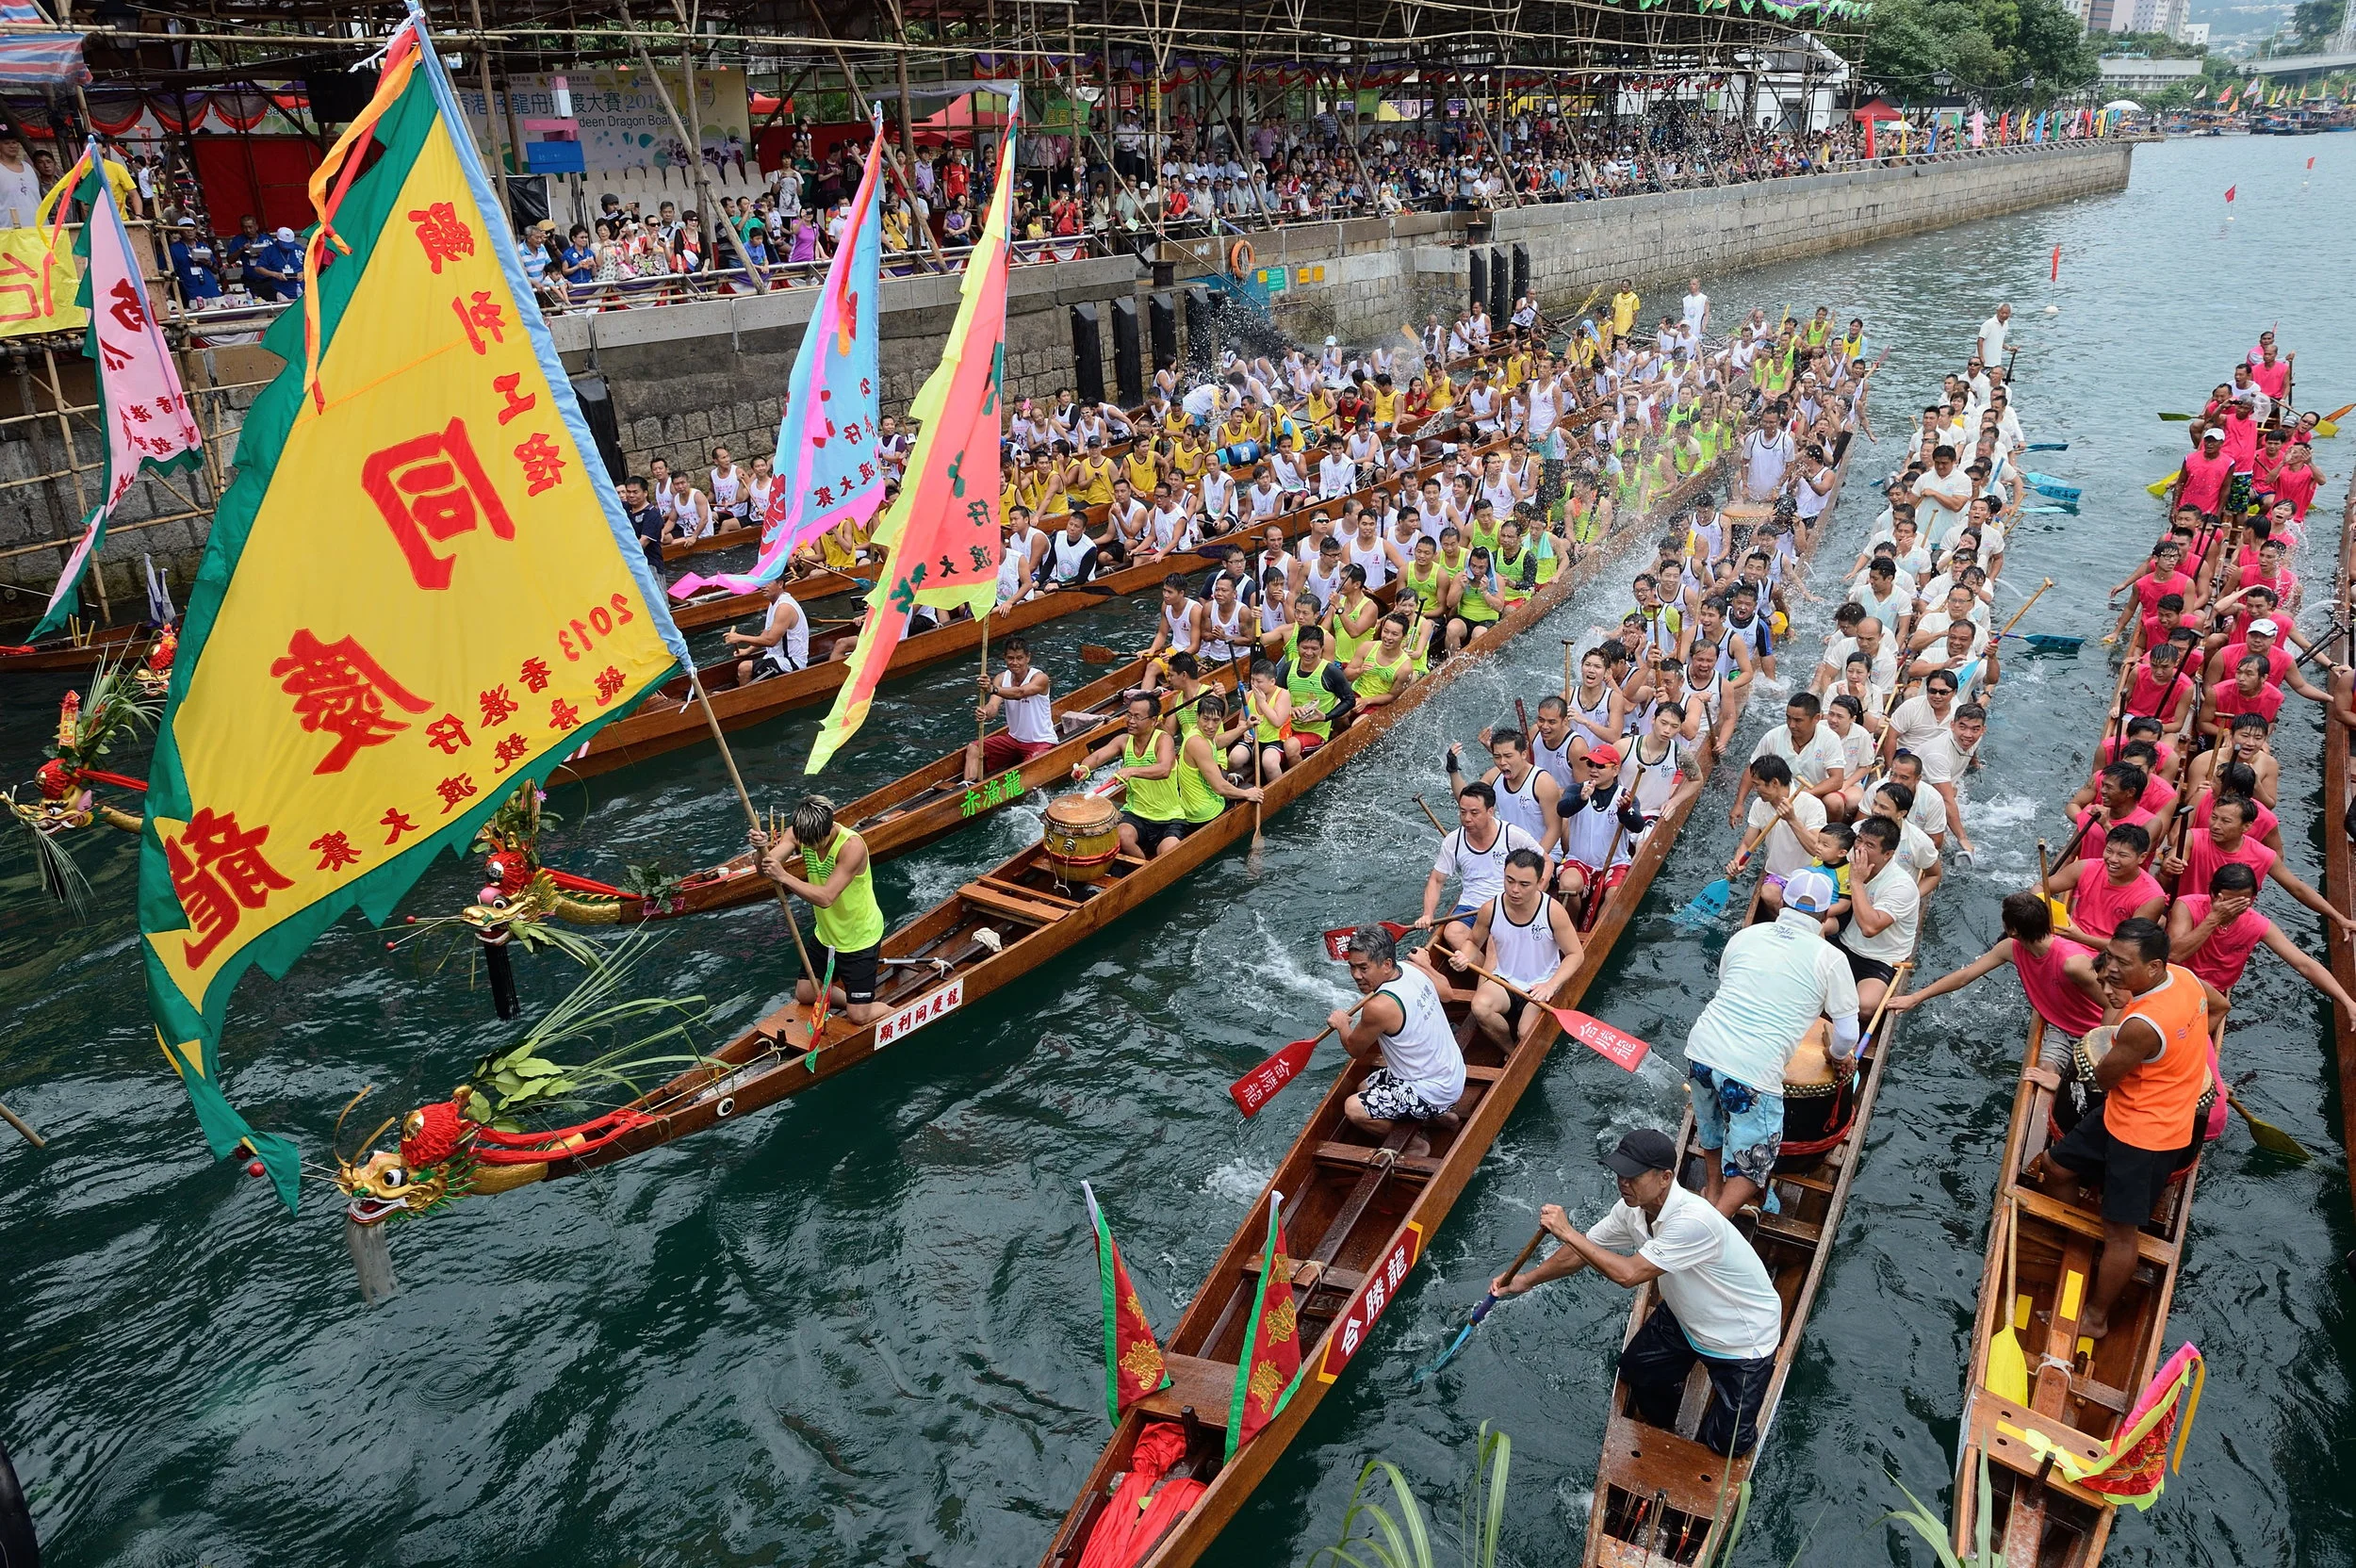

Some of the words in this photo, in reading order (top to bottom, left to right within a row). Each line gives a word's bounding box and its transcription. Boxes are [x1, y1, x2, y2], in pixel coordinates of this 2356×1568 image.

[459, 91, 621, 115] 香港仔龍舟渡大賽
[608, 115, 647, 129] Dragon
[648, 114, 672, 126] Boat
[959, 769, 1025, 818] 赤漁龍
[878, 987, 959, 1043] 顯利同慶龍
[1579, 1021, 1637, 1061] 合勝龍
[1242, 1058, 1291, 1108] 合勝龍
[1340, 1244, 1408, 1357] 合勝龍
